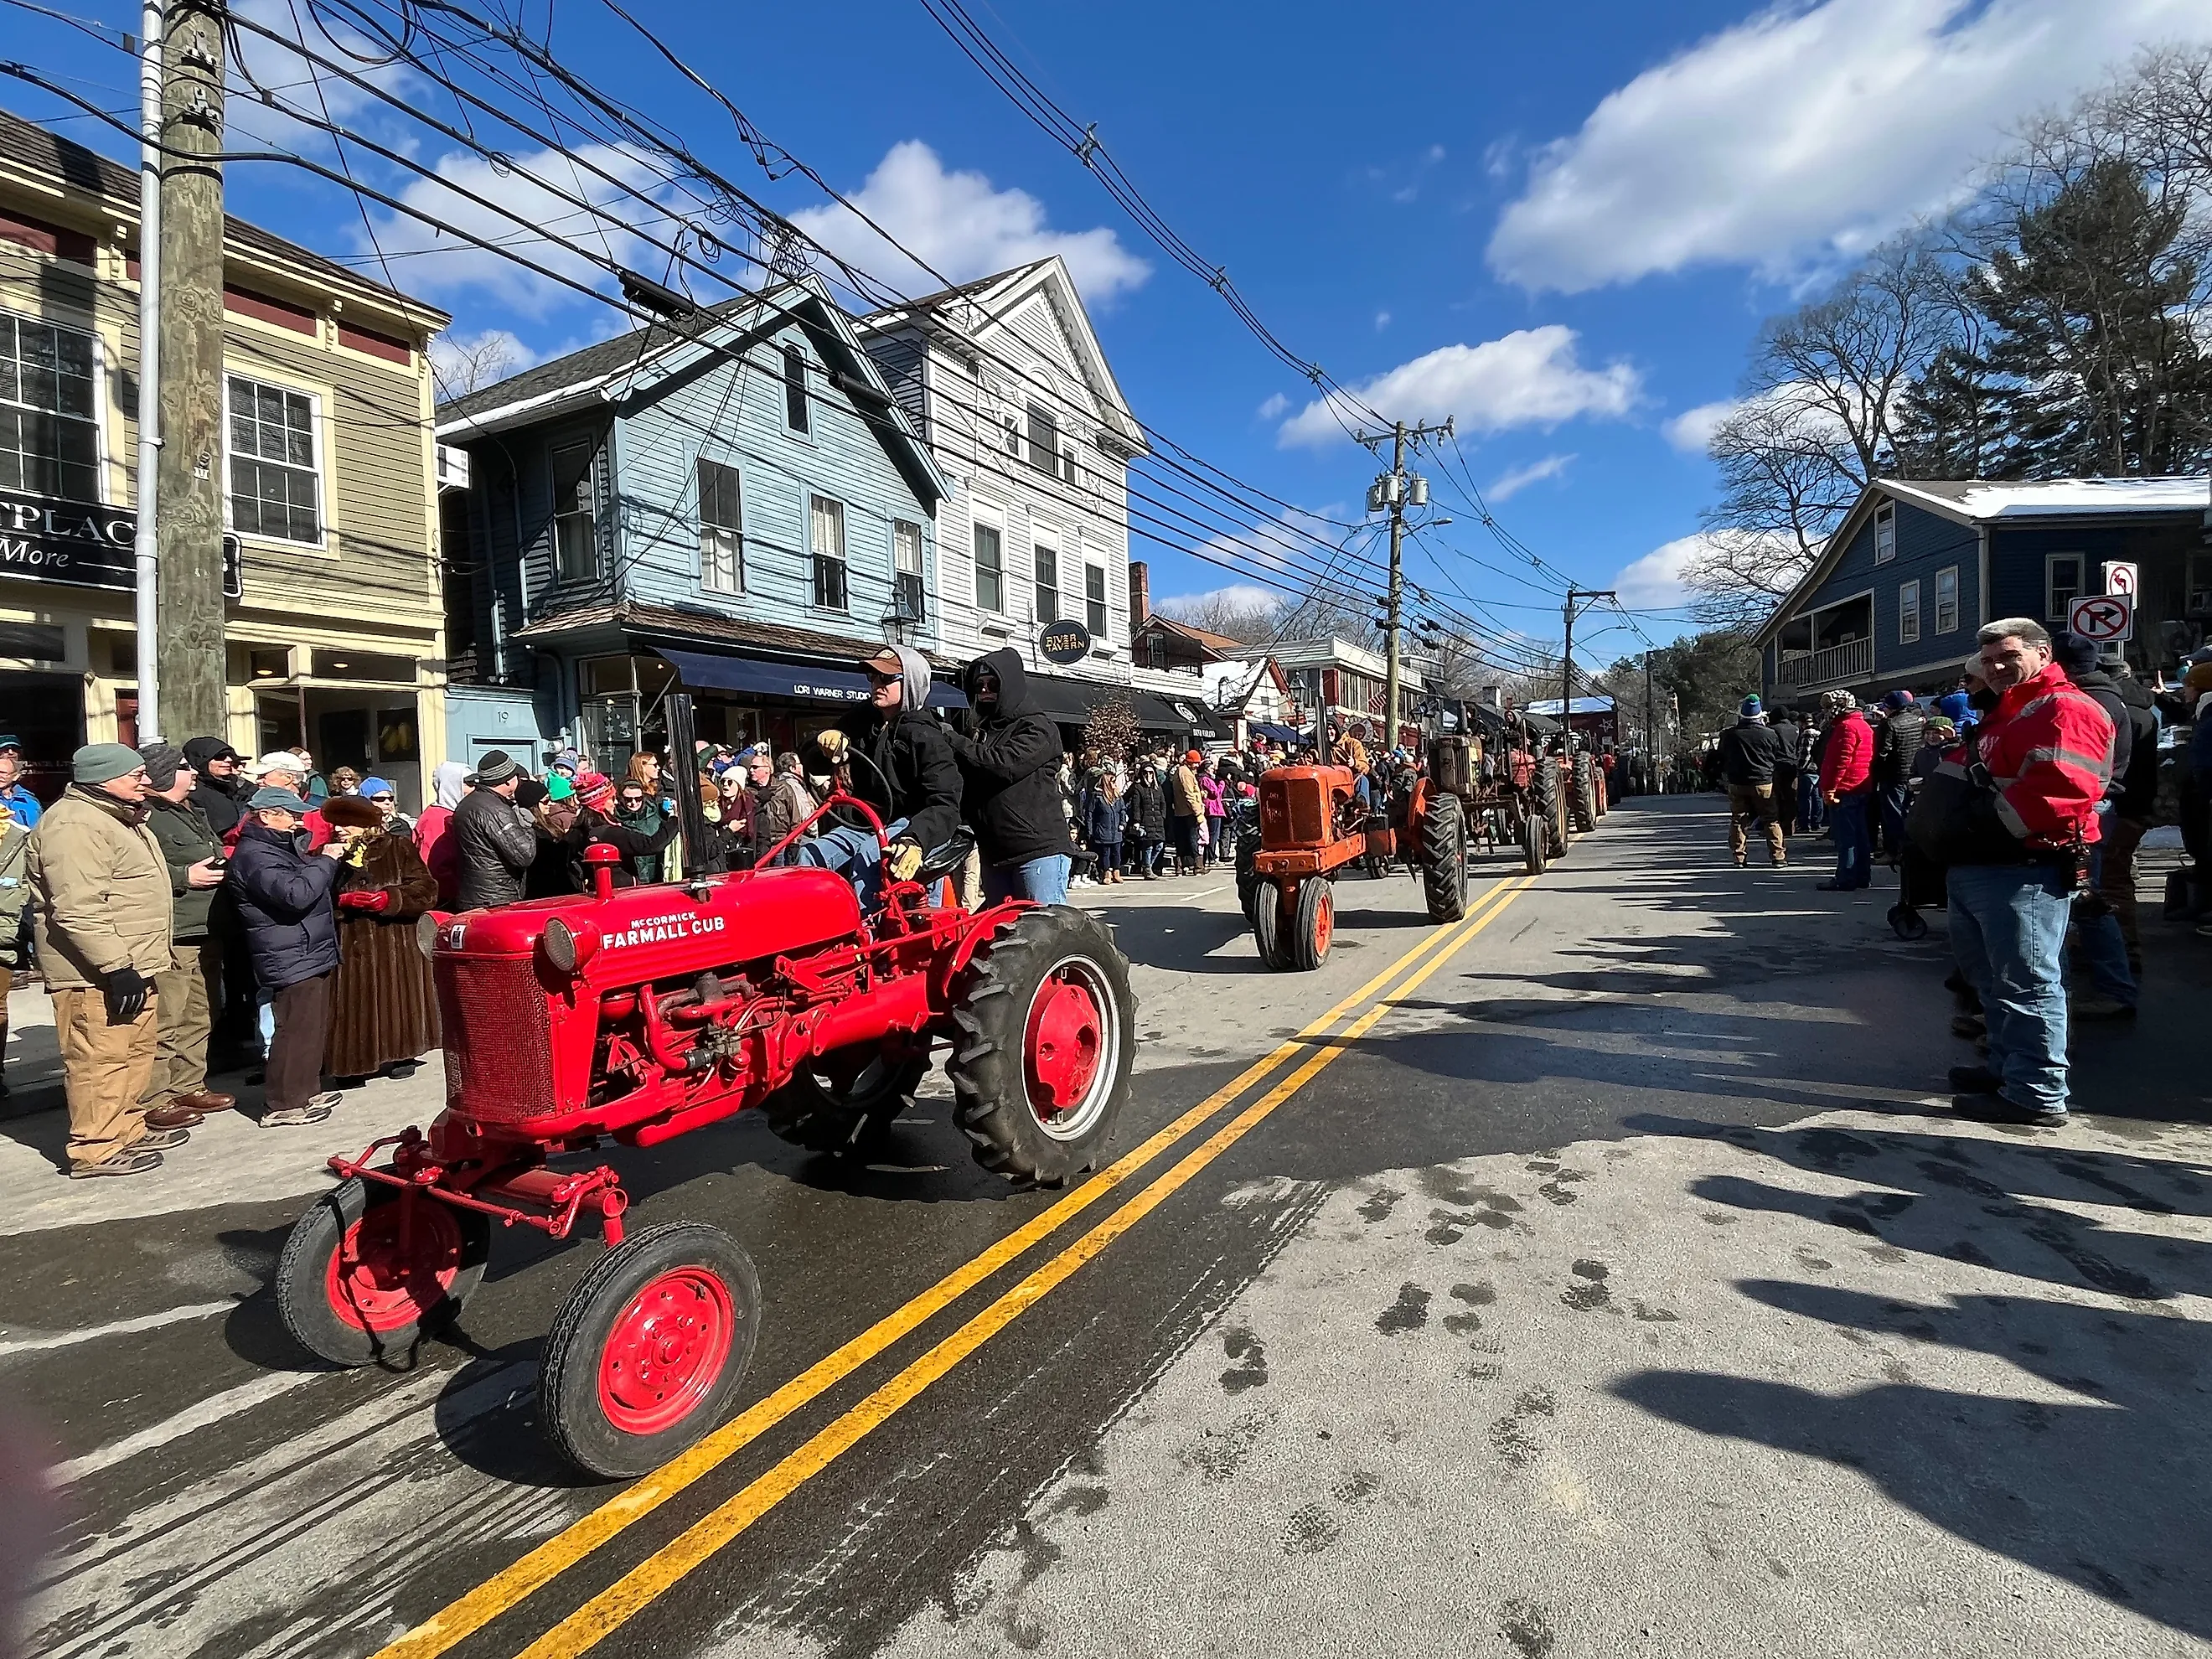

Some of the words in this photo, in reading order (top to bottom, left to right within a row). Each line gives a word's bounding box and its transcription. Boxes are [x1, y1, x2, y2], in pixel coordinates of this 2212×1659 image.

[0, 538, 70, 567] More
[1046, 633, 1077, 644] RIVER
[1046, 640, 1085, 652] TAVERN
[793, 685, 810, 695] LORI
[813, 686, 844, 698] WARNER
[497, 711, 509, 724] 19
[602, 923, 689, 950] FARMALL
[691, 916, 725, 935] CUB
